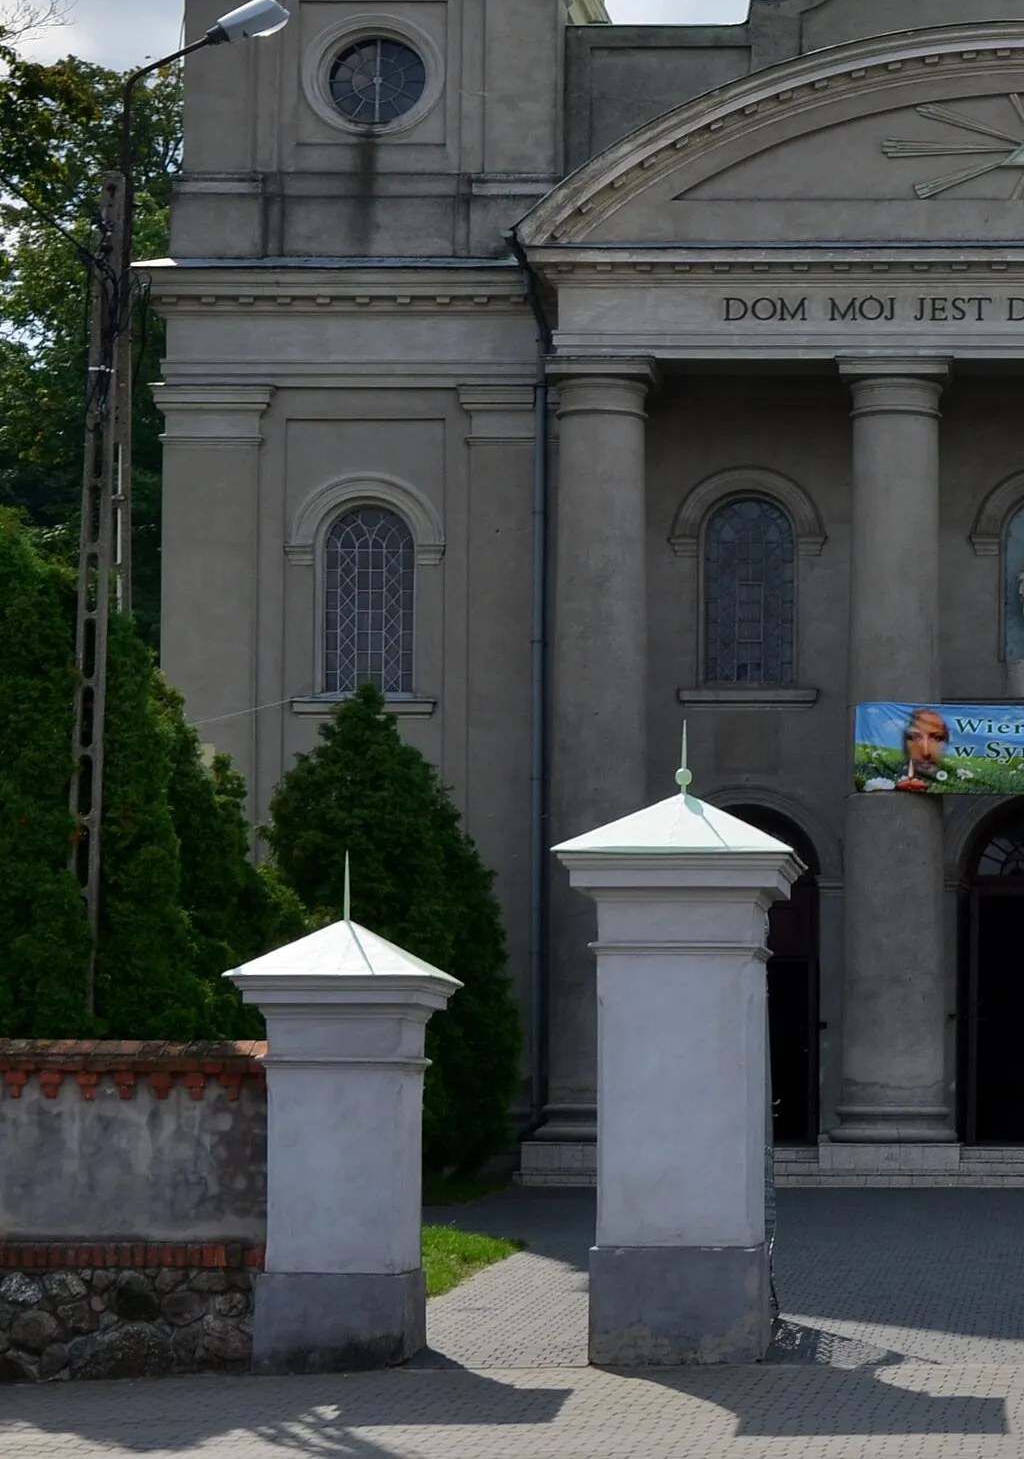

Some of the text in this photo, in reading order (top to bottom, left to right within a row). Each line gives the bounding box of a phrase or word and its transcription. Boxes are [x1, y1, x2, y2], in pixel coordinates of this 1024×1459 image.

[723, 297, 808, 321] DOM
[828, 294, 897, 321] MÓJ
[914, 297, 992, 321] JEST
[955, 746, 976, 758] w
